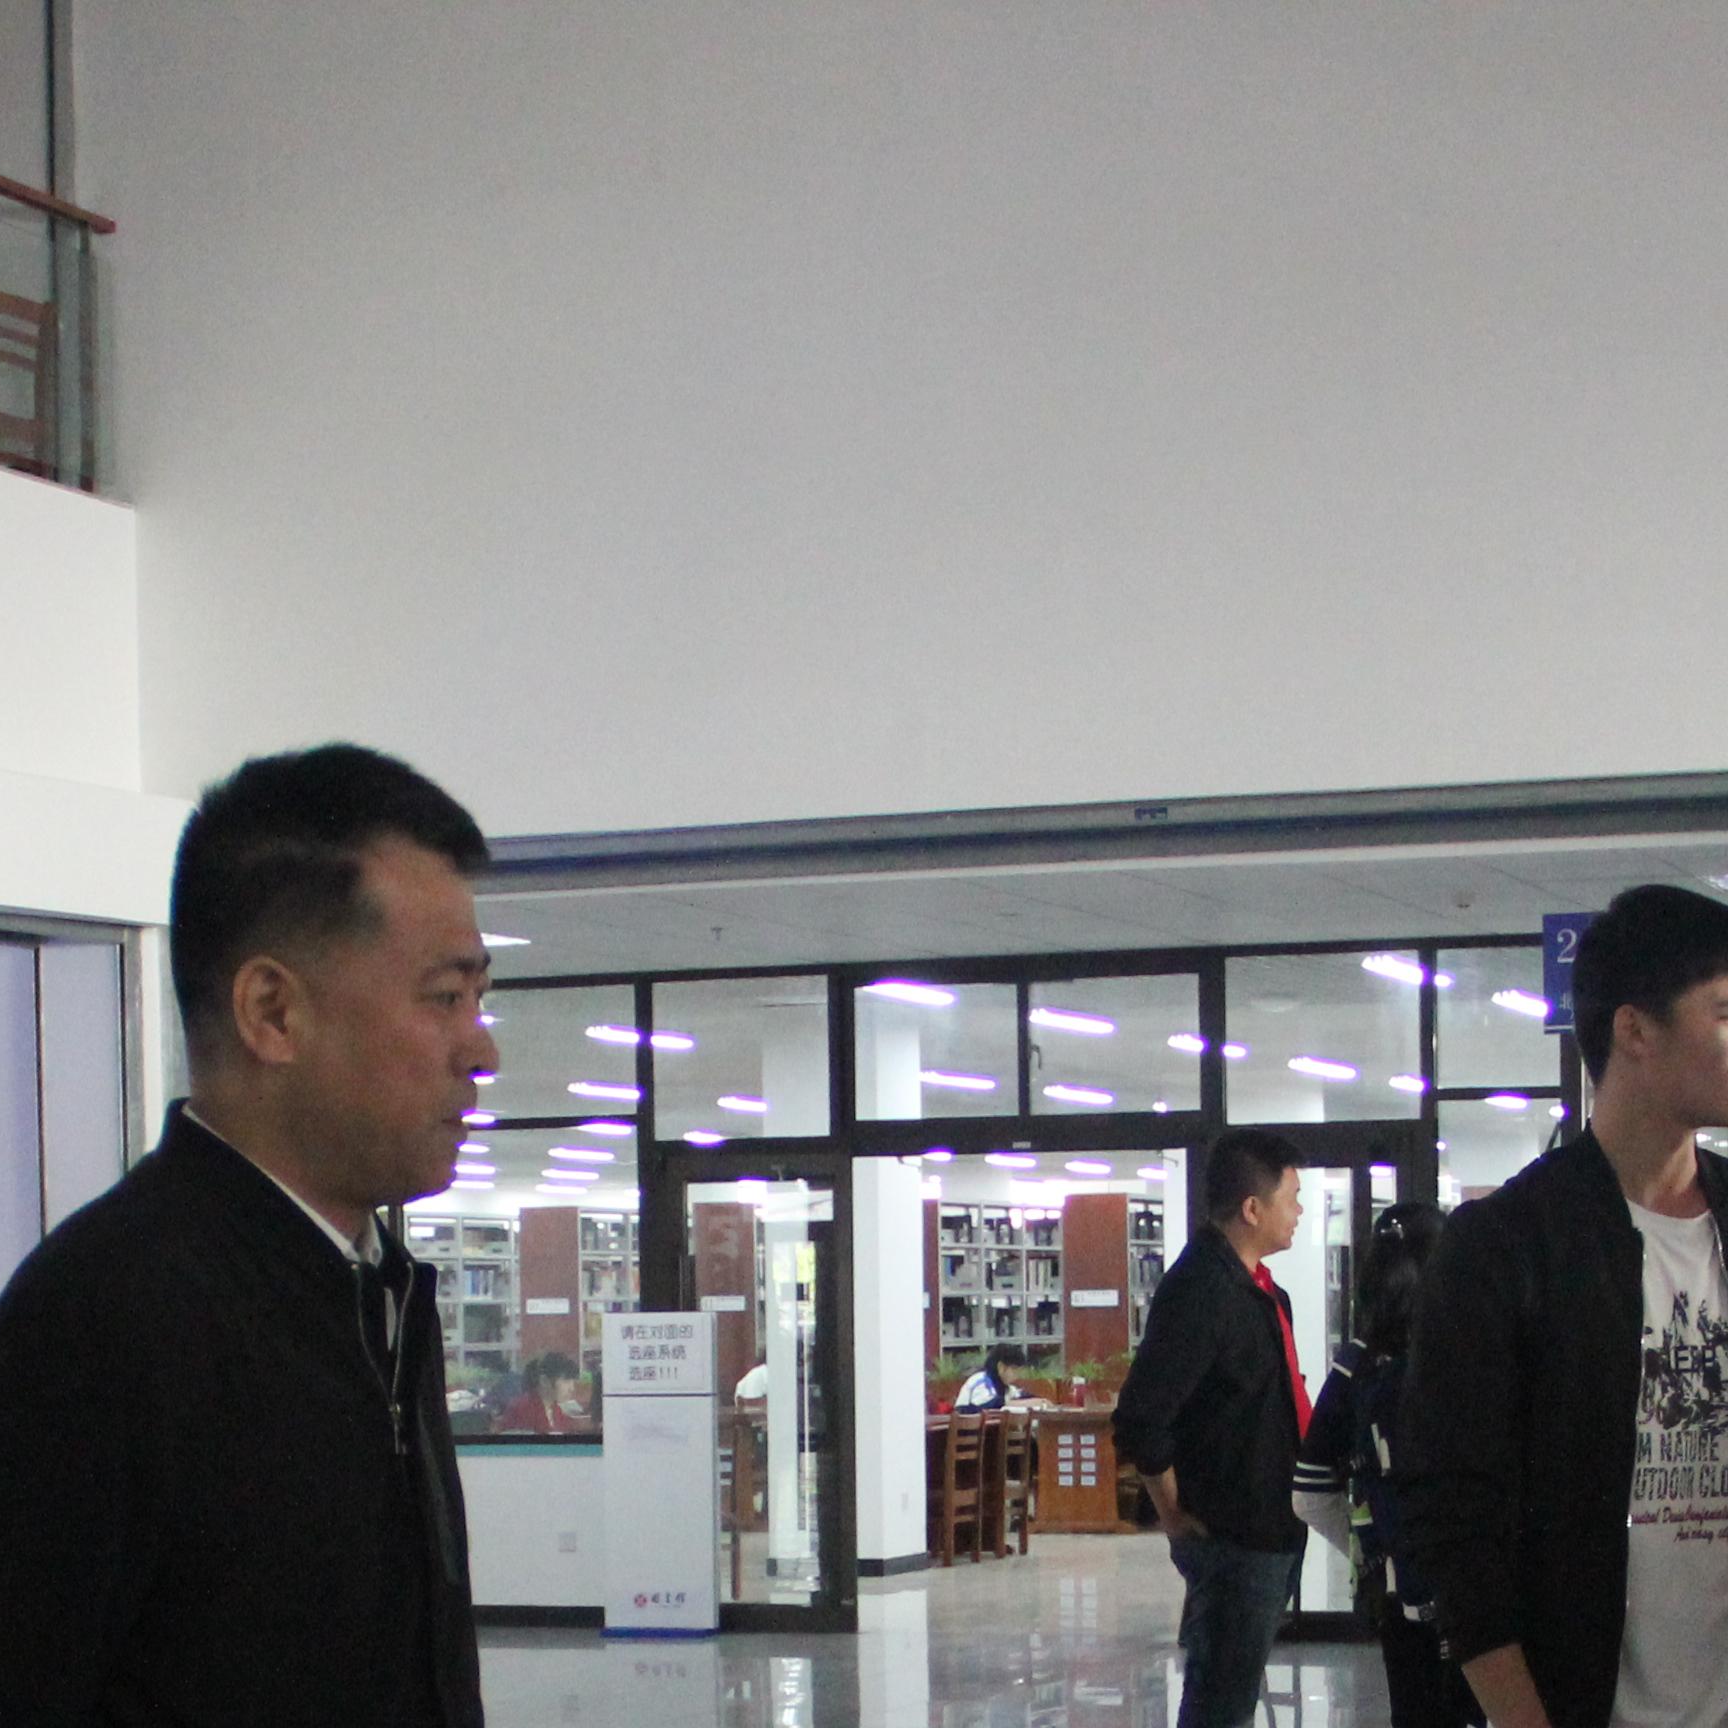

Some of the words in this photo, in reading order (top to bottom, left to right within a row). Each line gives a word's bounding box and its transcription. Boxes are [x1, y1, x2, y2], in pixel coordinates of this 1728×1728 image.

[1557, 927, 1578, 964] 2
[621, 1324, 693, 1340] 请在对面的
[629, 1344, 687, 1361] 选座系统
